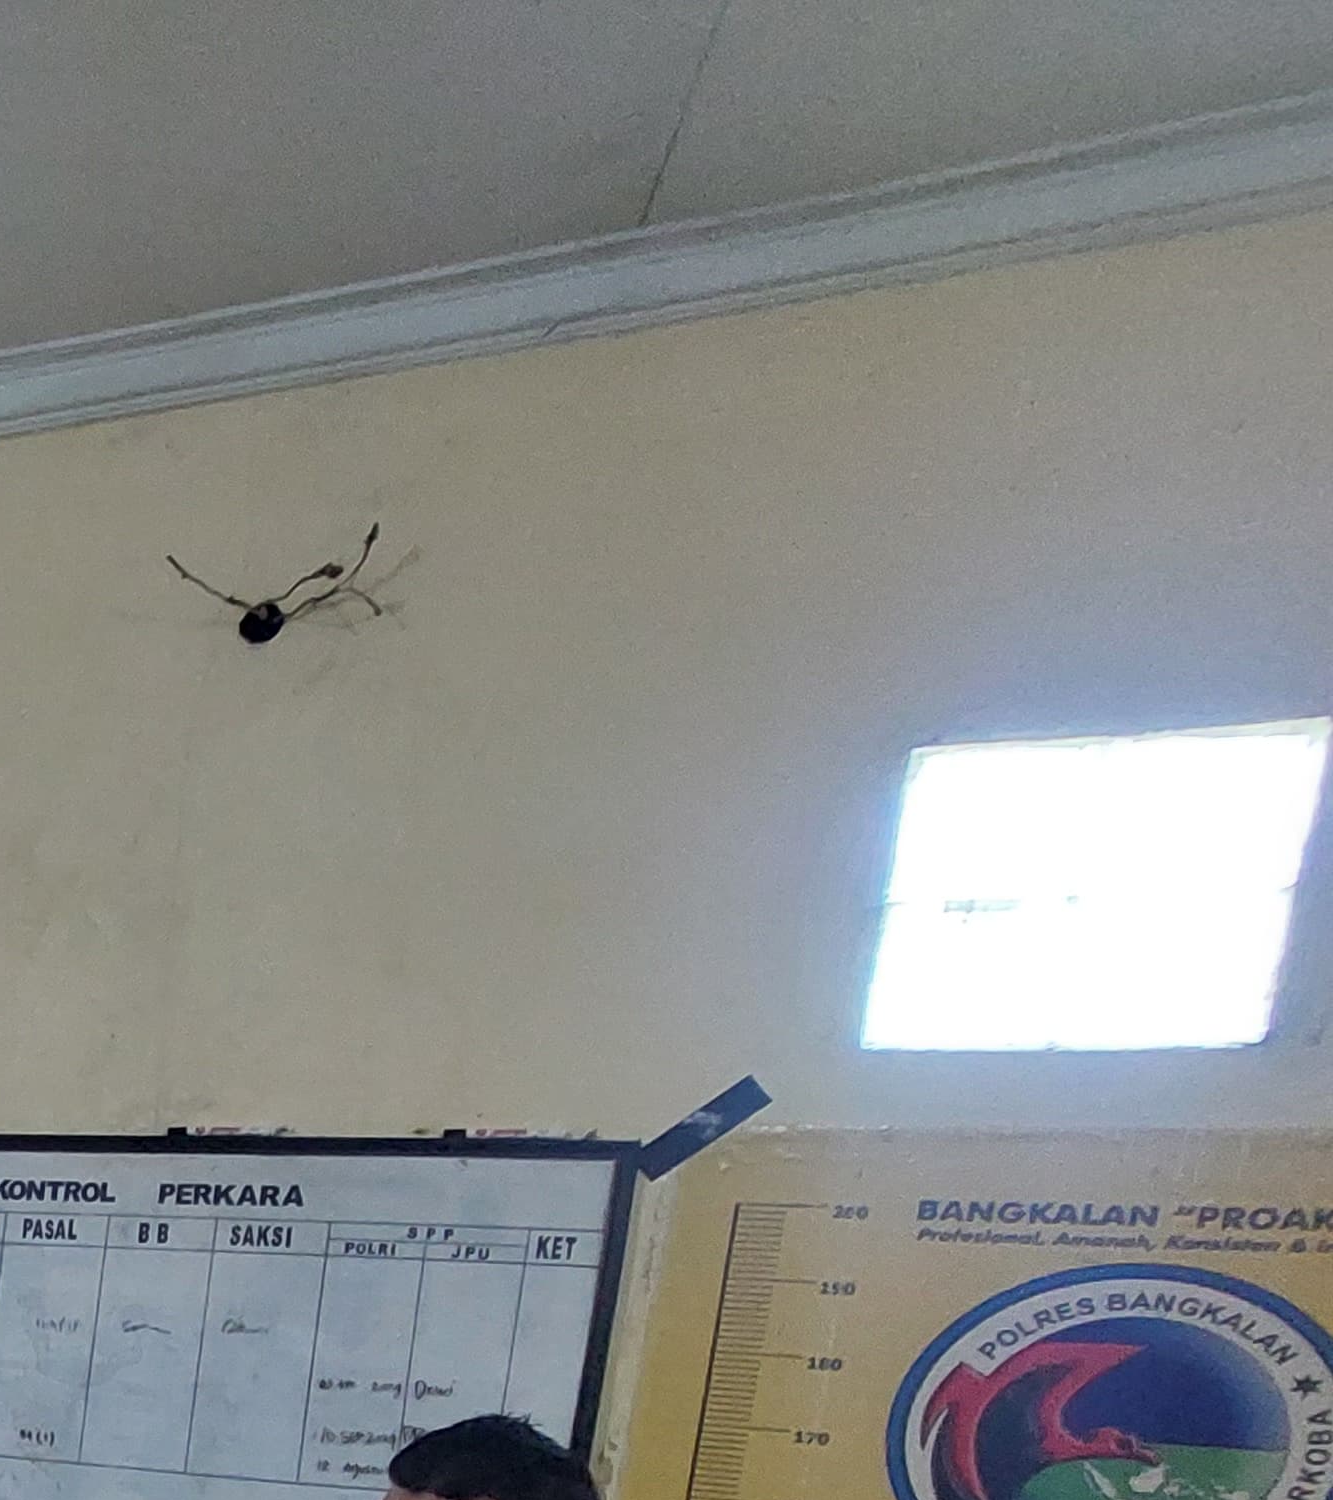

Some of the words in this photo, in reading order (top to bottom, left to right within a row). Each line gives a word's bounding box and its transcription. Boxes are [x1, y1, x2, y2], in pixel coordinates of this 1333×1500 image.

[158, 1183, 304, 1208] PERKARA
[917, 1199, 1160, 1227] BANGKALAN
[22, 1218, 77, 1241] PASAL
[230, 1225, 293, 1249] SAKSI
[344, 1242, 397, 1257] POLRI
[451, 1246, 491, 1261] JPU
[535, 1236, 577, 1261] KET
[978, 1296, 1095, 1360] POLRES
[1106, 1293, 1298, 1366] BANGKALAN
[793, 1430, 830, 1446] 170
